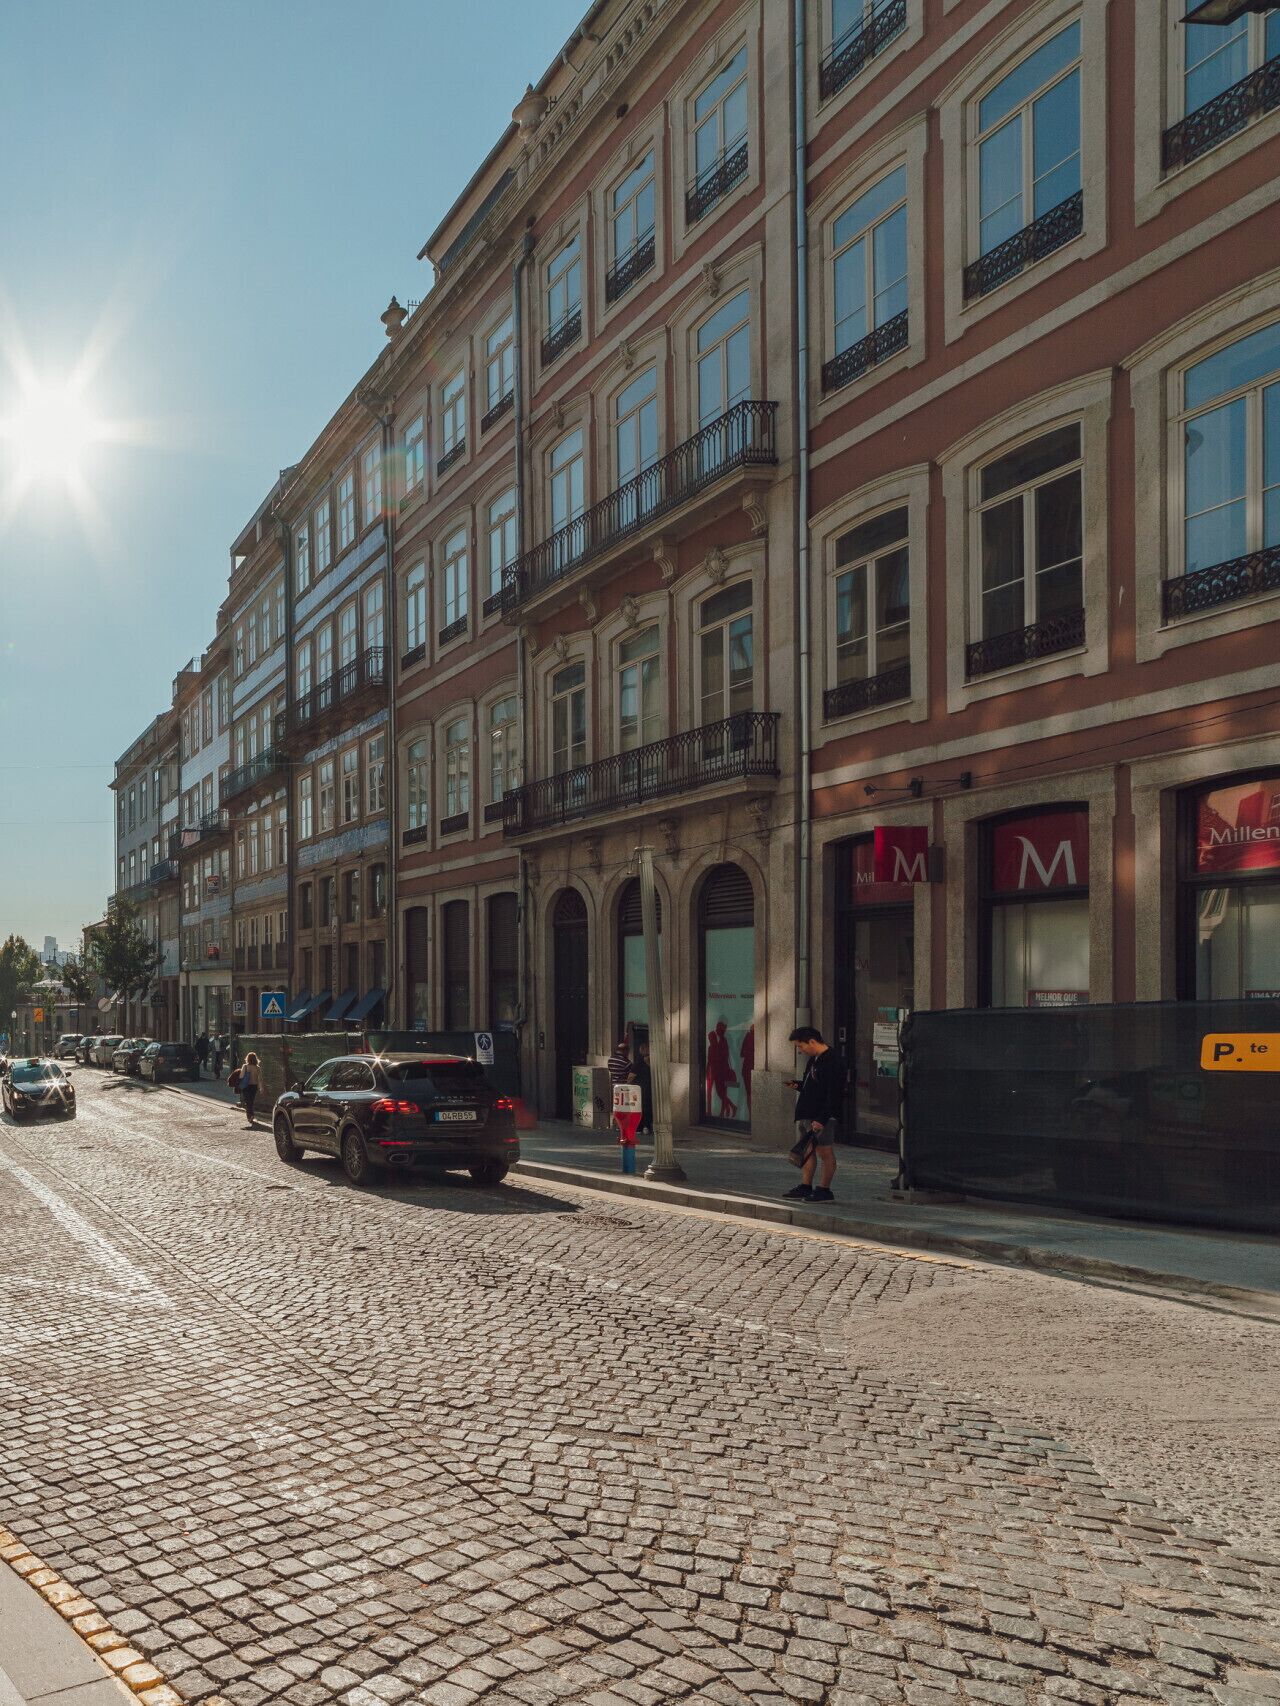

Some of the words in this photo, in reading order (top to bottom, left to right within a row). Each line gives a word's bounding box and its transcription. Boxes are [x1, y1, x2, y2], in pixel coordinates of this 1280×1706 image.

[1209, 825, 1280, 846] Millen
[890, 845, 928, 882] M
[1013, 836, 1078, 890] M
[1035, 992, 1063, 1002] MELHOR
[1063, 993, 1078, 1002] QUE
